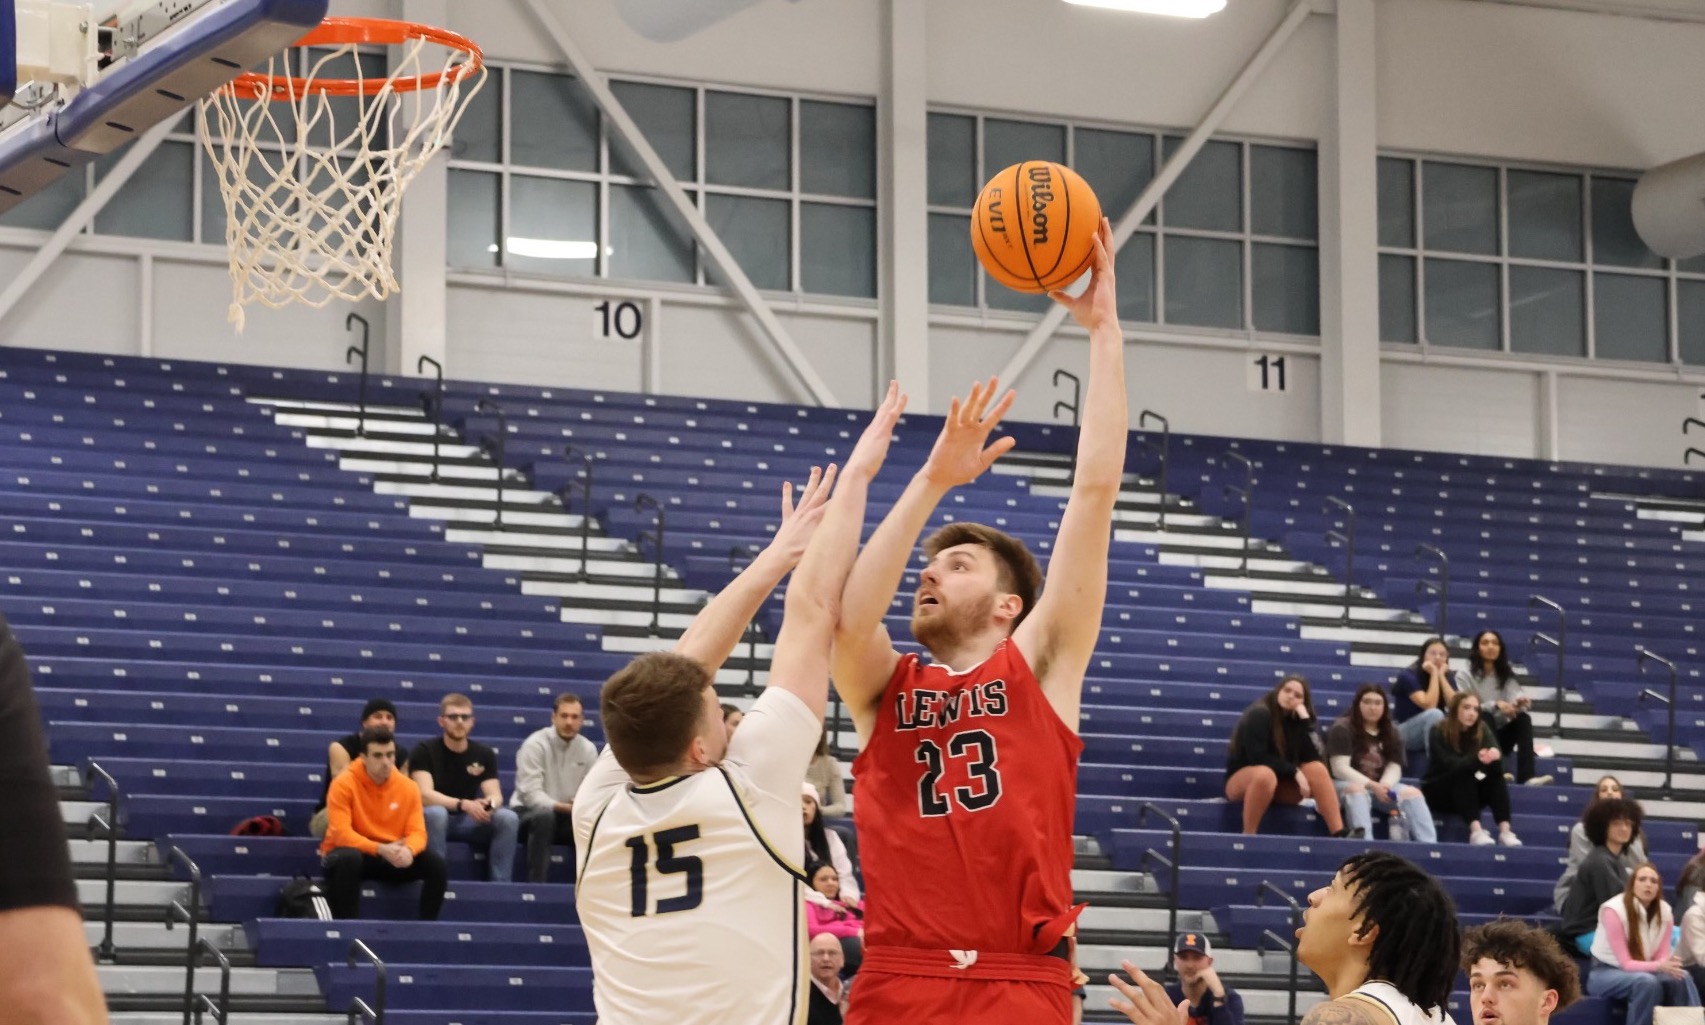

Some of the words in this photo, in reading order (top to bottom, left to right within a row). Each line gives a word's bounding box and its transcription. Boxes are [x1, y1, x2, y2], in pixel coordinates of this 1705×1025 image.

[1028, 166, 1054, 246] Wilson
[594, 300, 642, 339] 10
[1253, 355, 1285, 391] 11
[894, 678, 1009, 732] LEWIS
[914, 728, 1003, 818] 23
[624, 823, 703, 917] 15
